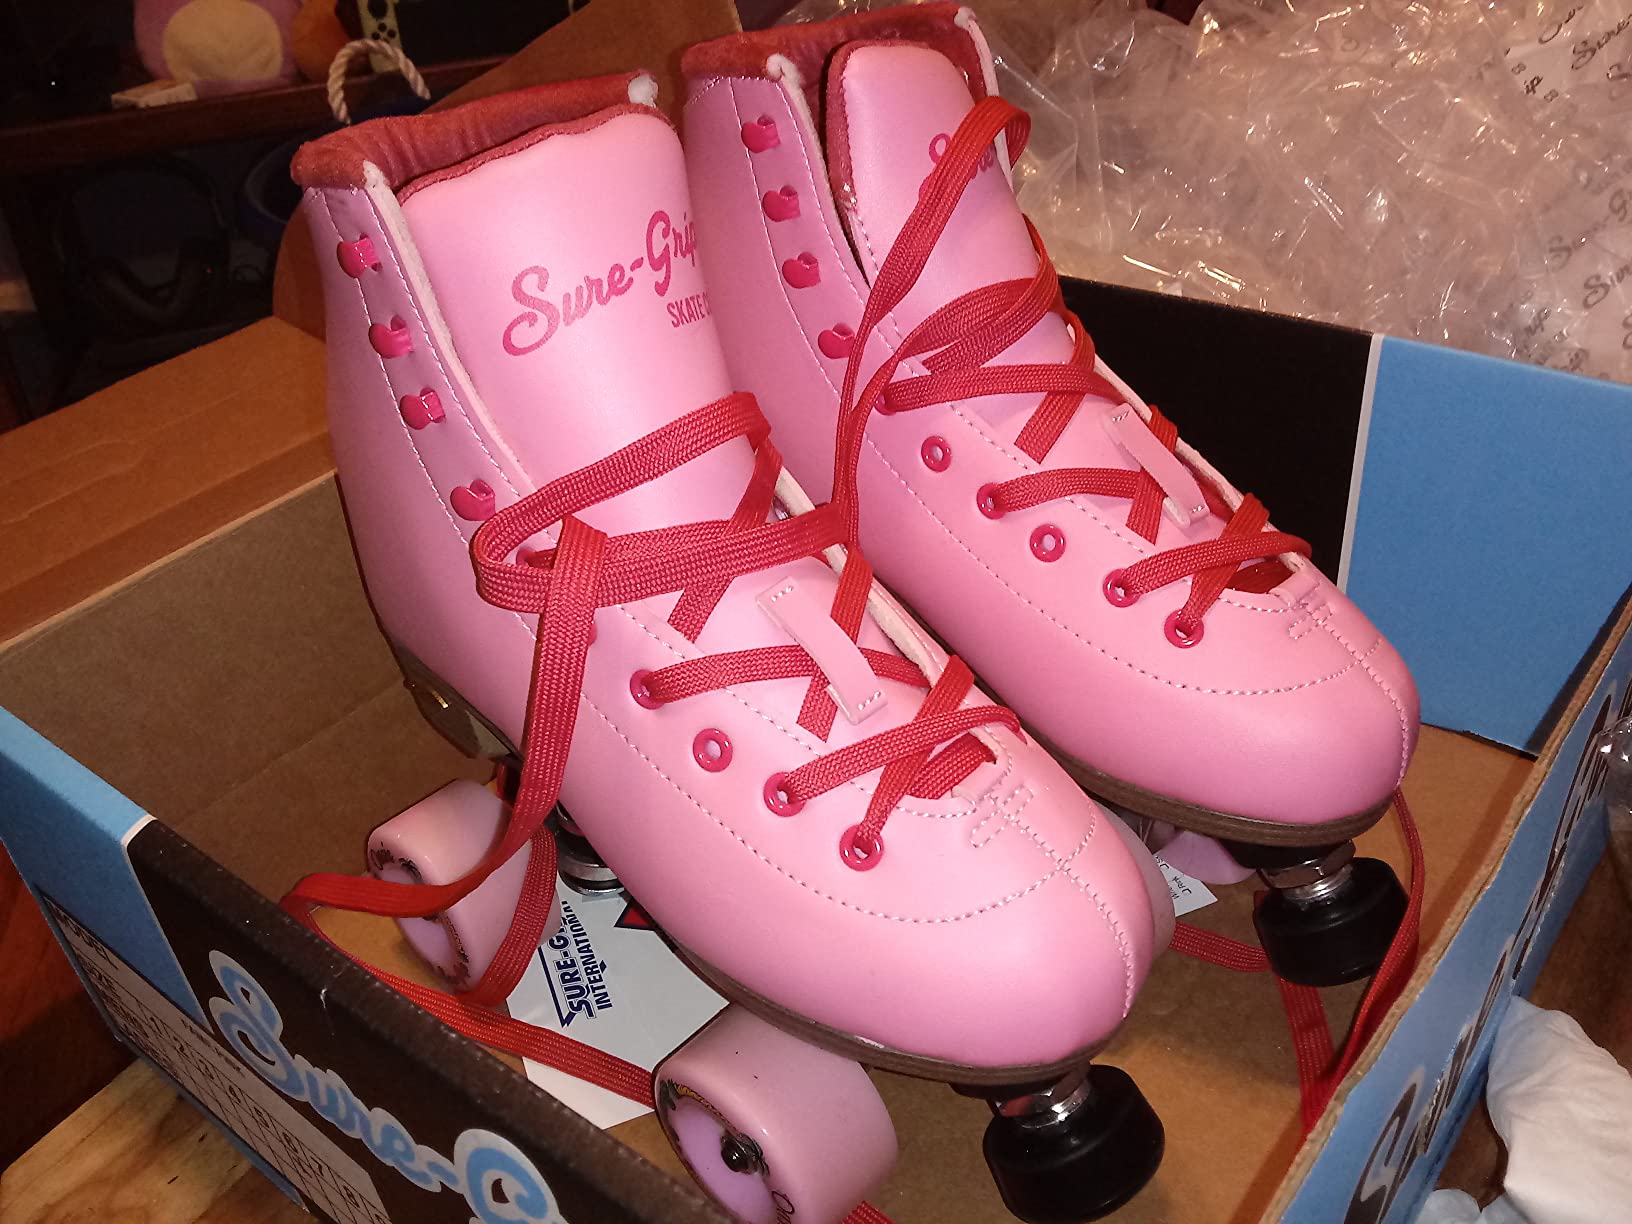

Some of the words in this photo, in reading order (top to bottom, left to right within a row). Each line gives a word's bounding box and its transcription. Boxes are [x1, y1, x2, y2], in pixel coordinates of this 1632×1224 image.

[502, 210, 698, 356] Sure-Grip
[666, 294, 705, 328] SKATE
[548, 917, 595, 1019] SURE-G
[310, 1156, 325, 1178] 7
[342, 1185, 361, 1209] 8
